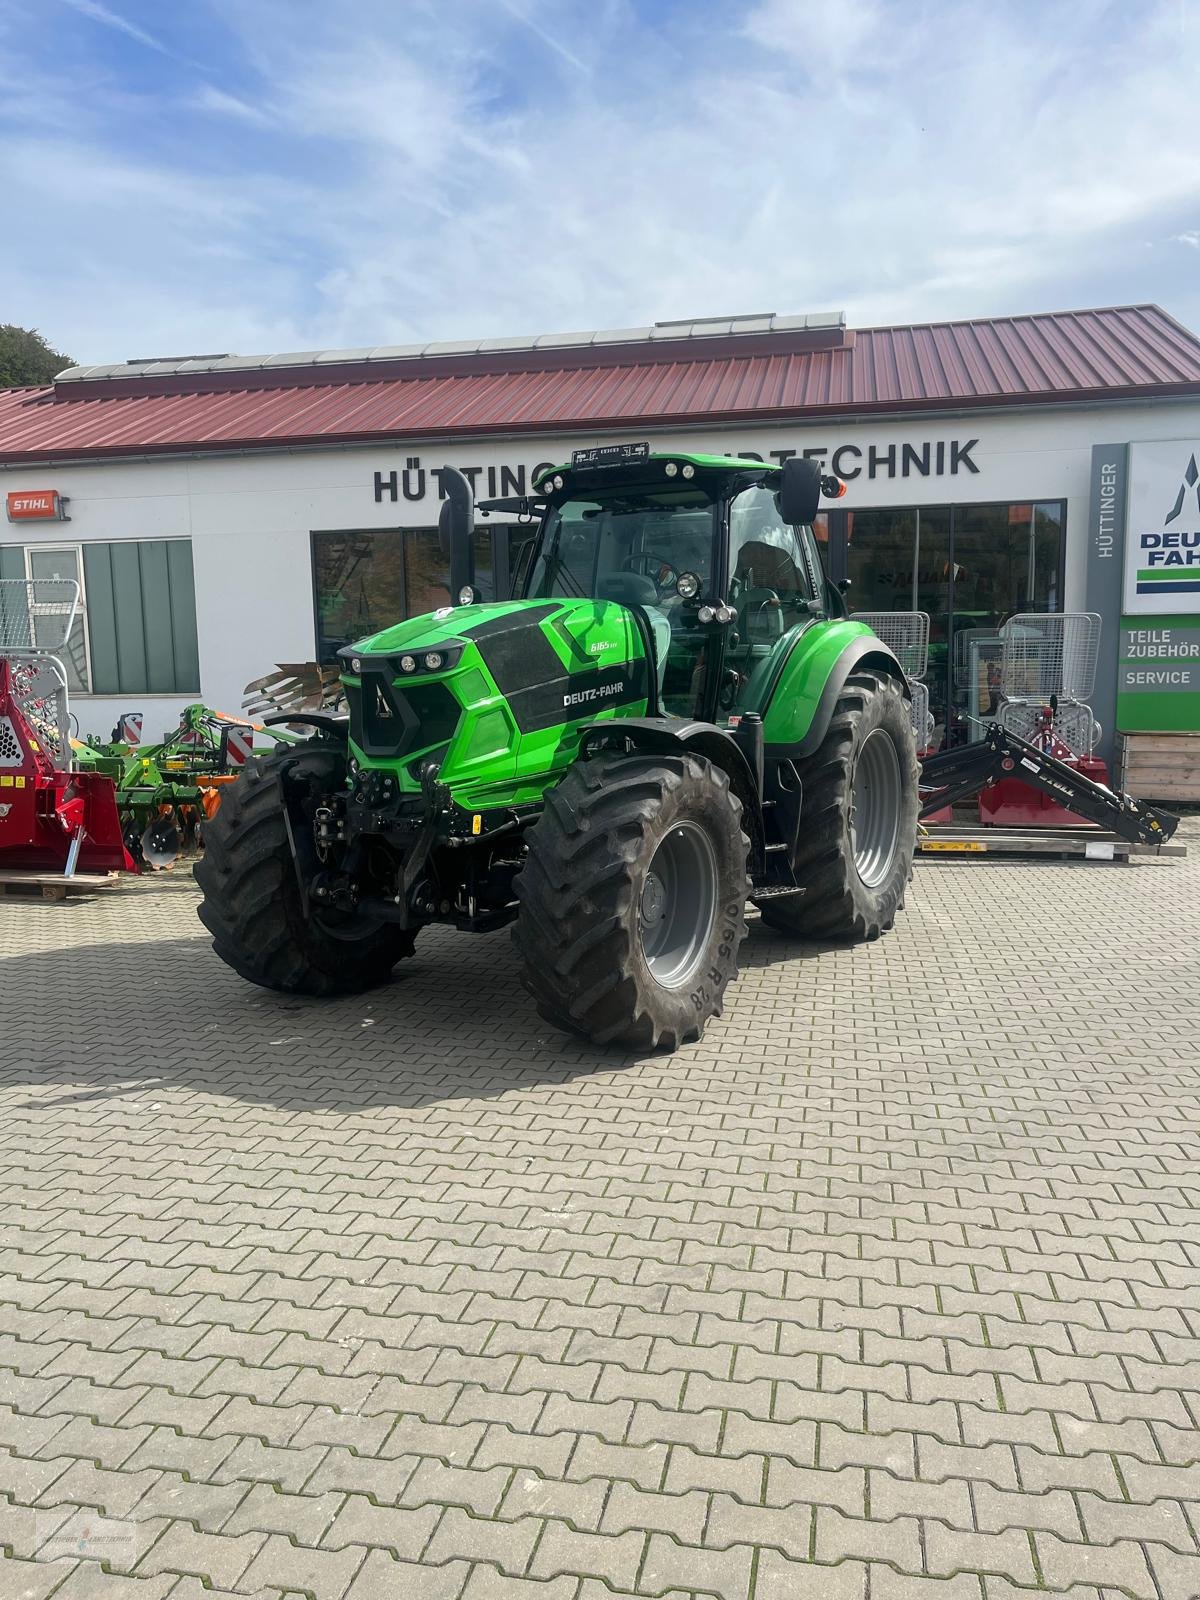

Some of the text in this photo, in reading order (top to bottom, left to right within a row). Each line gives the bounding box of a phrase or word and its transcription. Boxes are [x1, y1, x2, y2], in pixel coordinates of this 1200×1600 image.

[13, 499, 49, 510] STIHL
[1095, 463, 1117, 558] HÜTTINGER
[1127, 630, 1171, 643] TEILE
[591, 640, 609, 652] 6165
[1127, 641, 1200, 658] ZUBEHÖR
[1125, 671, 1191, 684] SERVICE
[563, 681, 624, 707] DEUTZ-FAHR
[707, 966, 722, 987] R
[689, 984, 710, 1012] 28
